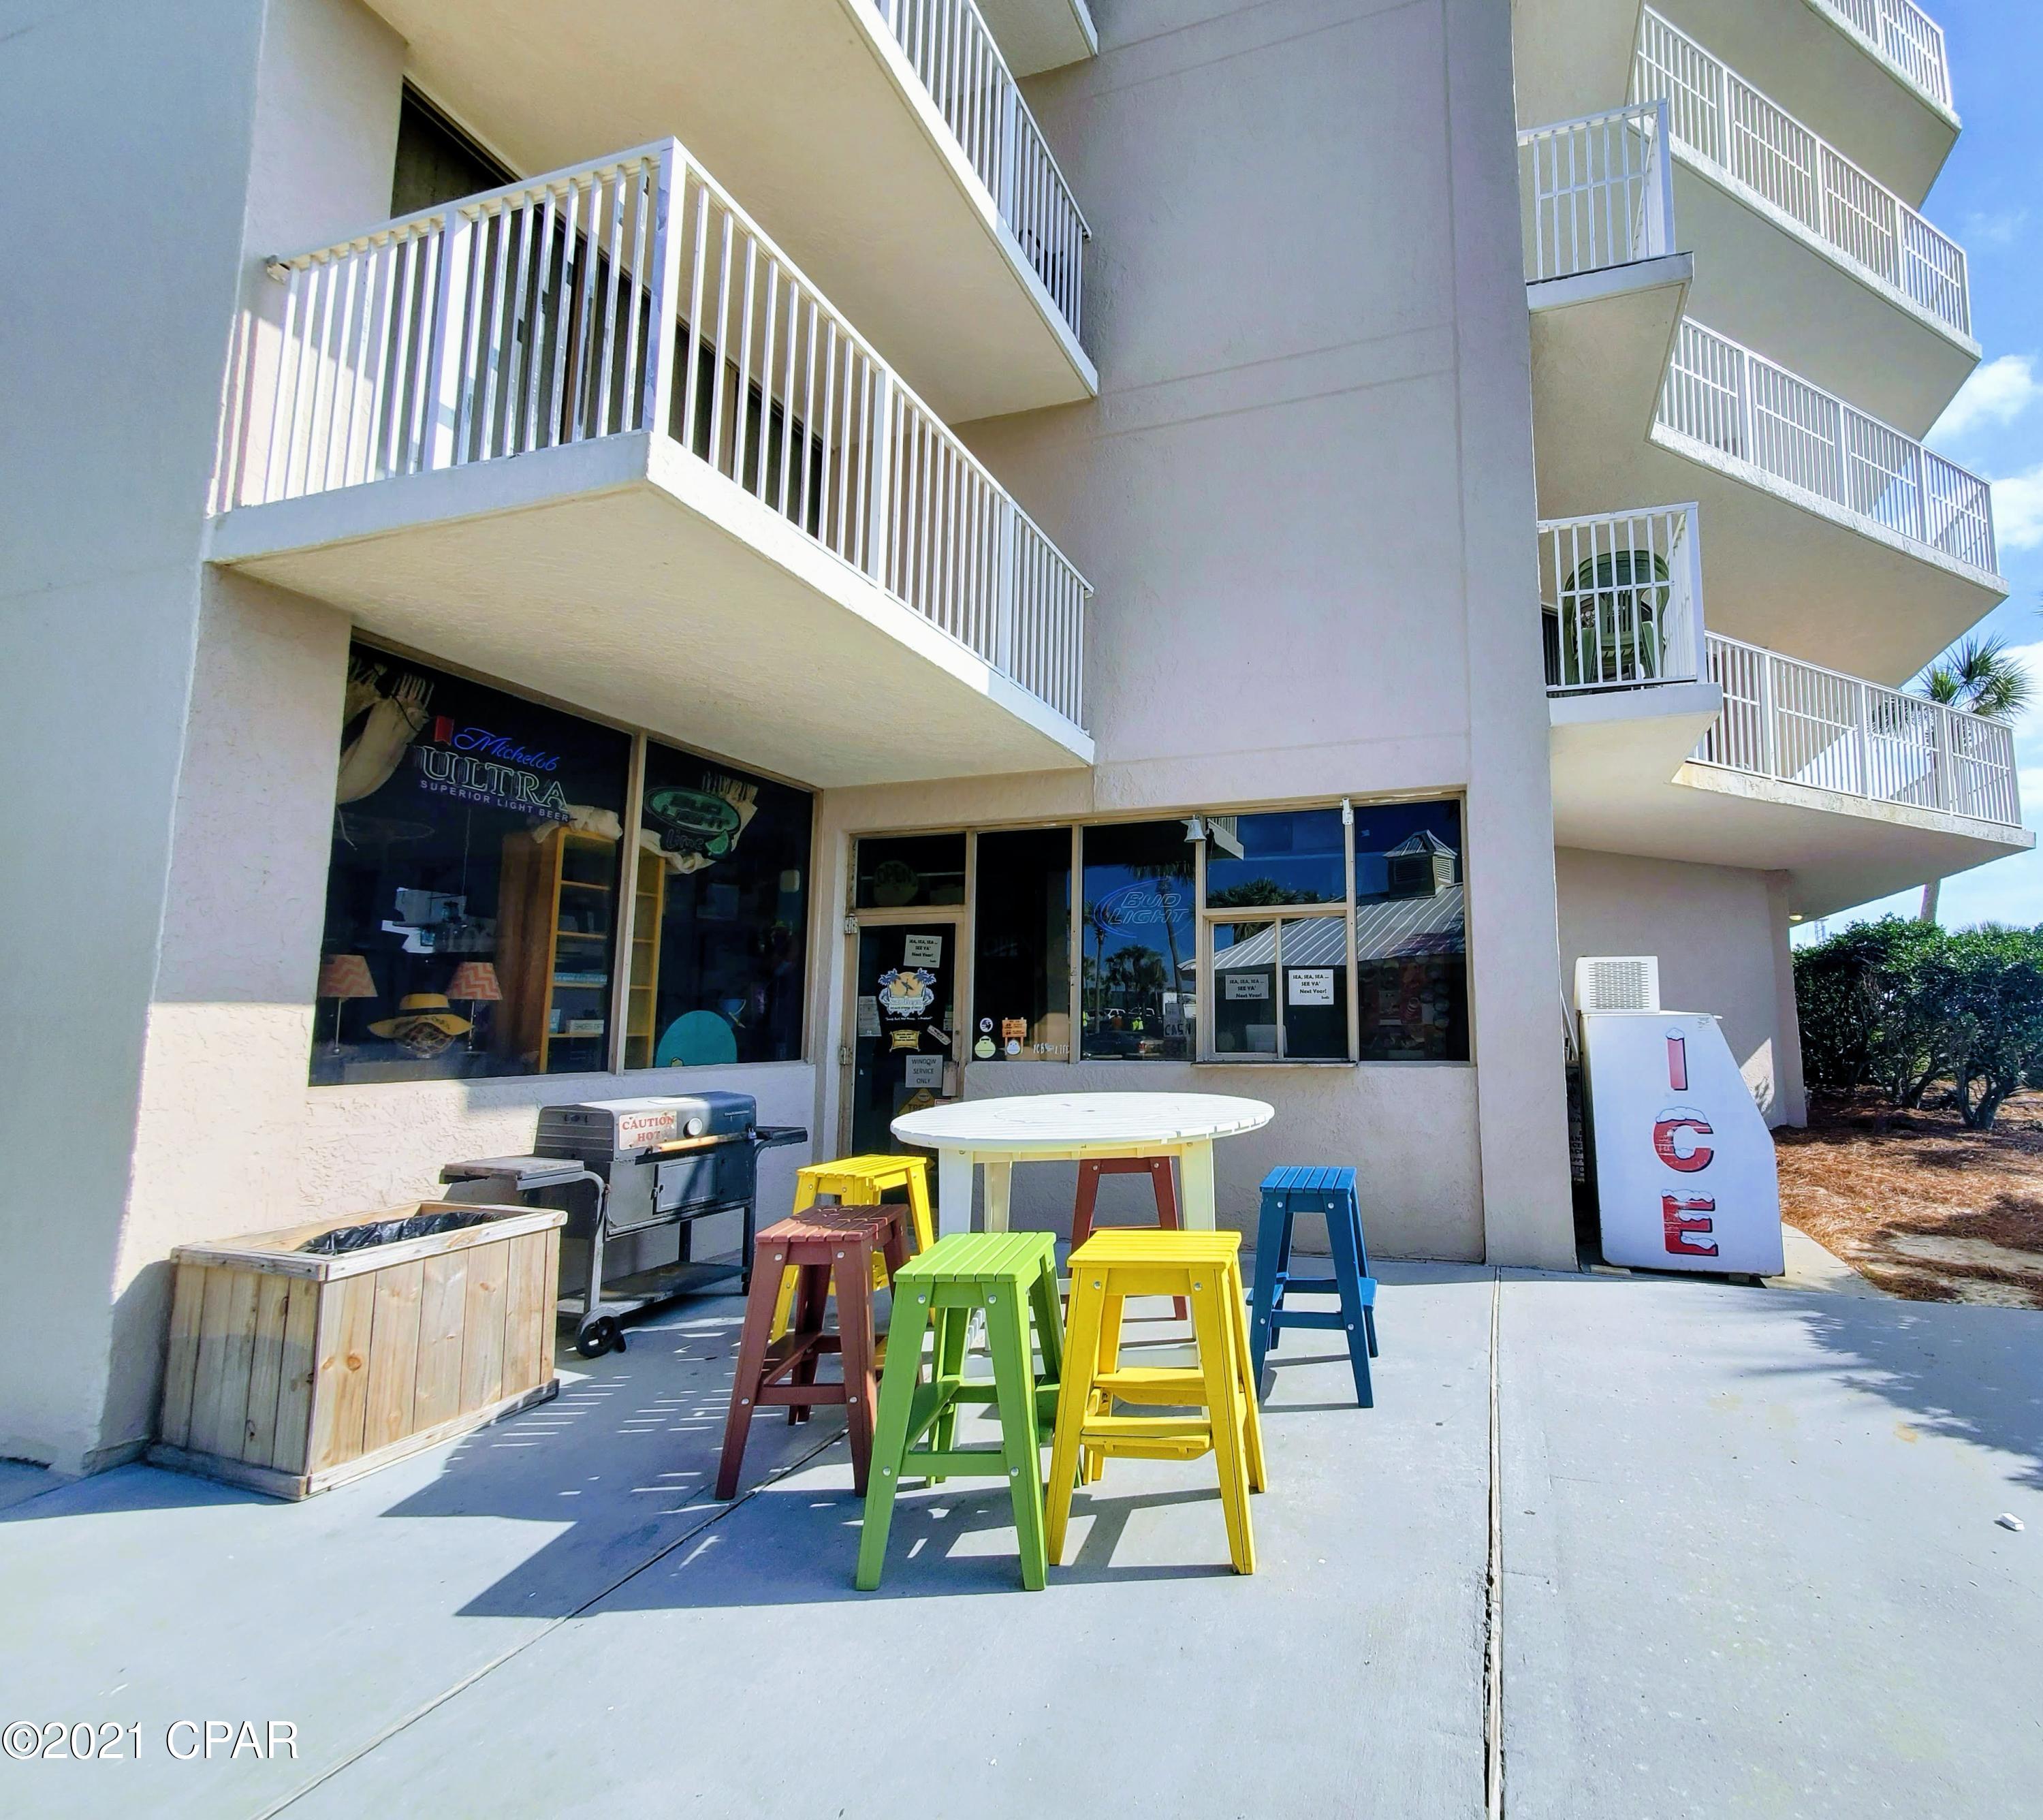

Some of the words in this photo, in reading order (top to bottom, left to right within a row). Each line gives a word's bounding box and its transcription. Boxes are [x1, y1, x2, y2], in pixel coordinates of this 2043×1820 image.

[454, 727, 560, 771] Michelob
[419, 745, 570, 812] ULTRA
[420, 780, 490, 804] SUPERIOR
[497, 800, 534, 814] LIGHT
[539, 809, 570, 823] BEER
[1121, 891, 1182, 909] BUD
[1108, 907, 1189, 925] LIGHT
[622, 1116, 674, 1130] CAUTION
[637, 1131, 661, 1142] HOT
[1653, 1027, 1719, 1257] ICE
